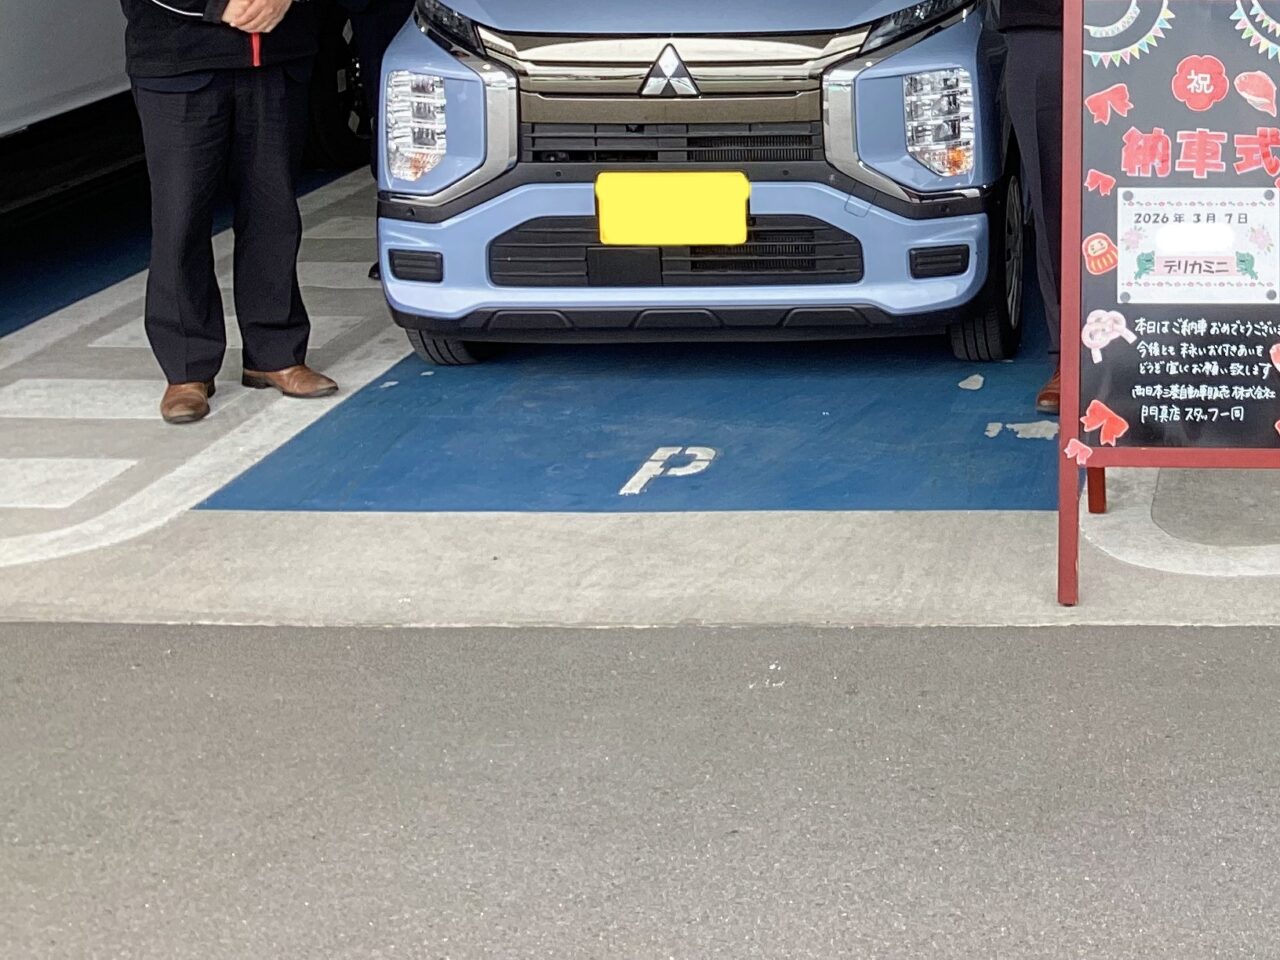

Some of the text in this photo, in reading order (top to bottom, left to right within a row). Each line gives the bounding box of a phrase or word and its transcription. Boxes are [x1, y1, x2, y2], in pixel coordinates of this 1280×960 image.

[1185, 70, 1214, 95] 祝
[1163, 259, 1230, 275] デリカミニ
[618, 446, 717, 496] P
